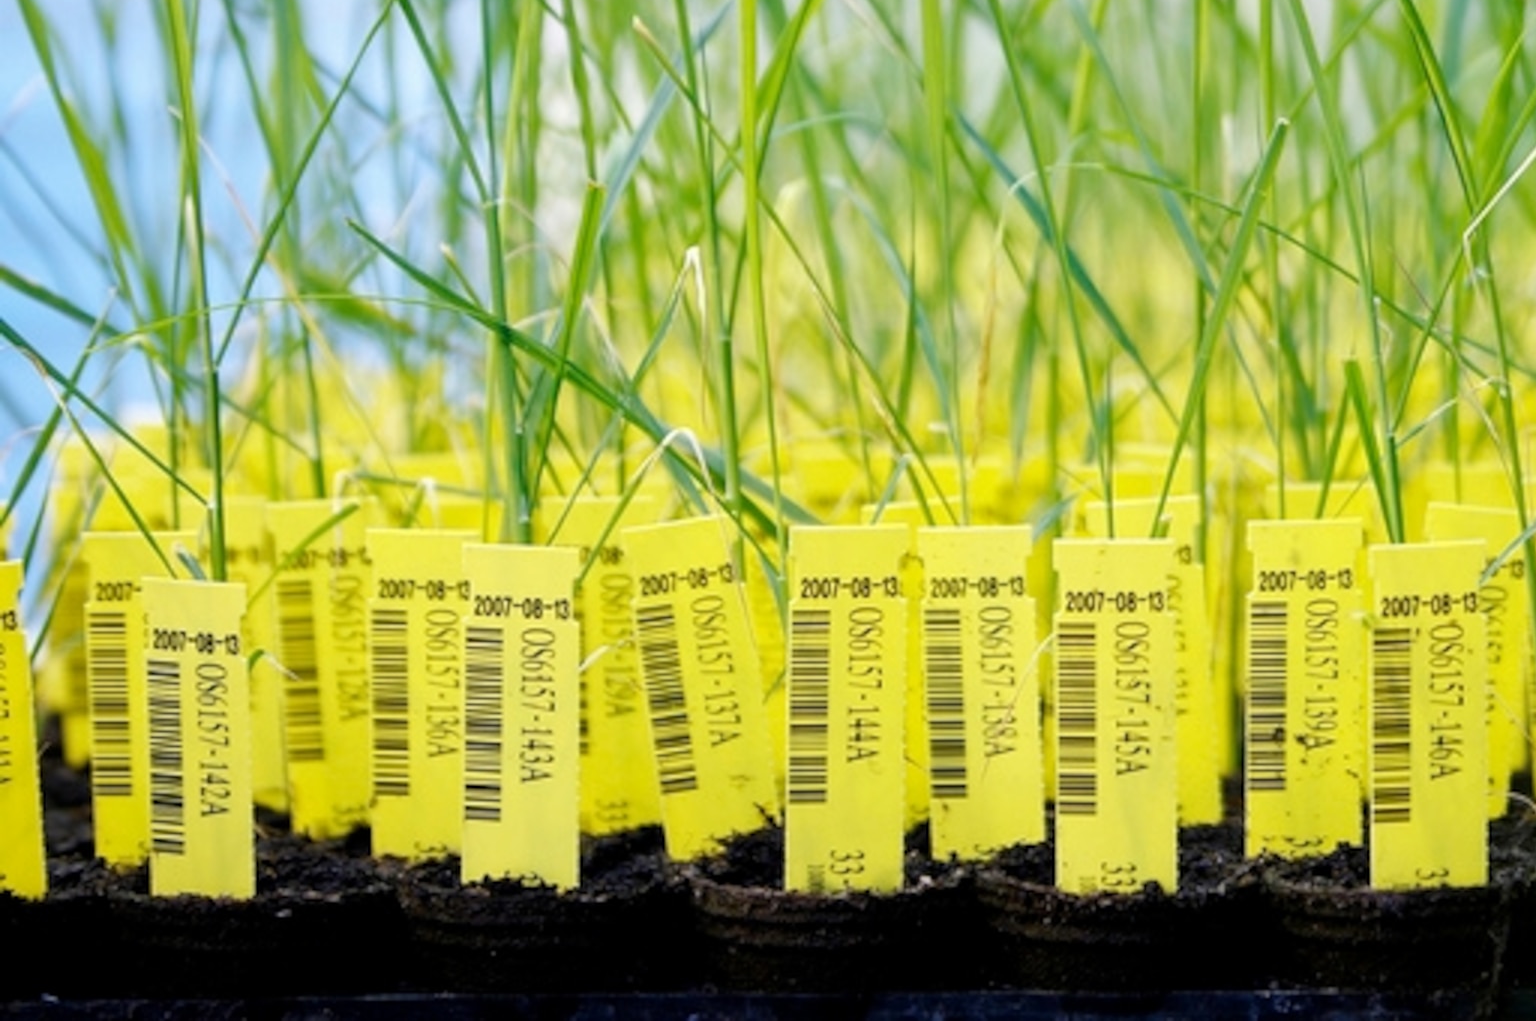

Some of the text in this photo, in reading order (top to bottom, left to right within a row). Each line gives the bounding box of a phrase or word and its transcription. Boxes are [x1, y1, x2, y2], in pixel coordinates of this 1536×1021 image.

[378, 579, 471, 600] 2007-08-13
[474, 595, 570, 619] 2007-08-13
[640, 563, 733, 595] 2007-08-13
[800, 576, 898, 599] 2007-08-13
[930, 576, 1024, 599] 2007-08-13
[1065, 591, 1165, 614] 2007-08-13
[1259, 569, 1353, 592] 2007-08-13
[1381, 592, 1478, 617] 2007-08-13
[153, 629, 239, 655] 2007-08-13
[424, 608, 460, 759] OS6157-136A
[691, 594, 742, 748] OS6157-137A
[846, 606, 883, 763] OS6157-144A
[978, 606, 1017, 758] OS6157-138A
[1304, 598, 1340, 752] OS6157-139A
[196, 663, 229, 817] OS6157-142A
[520, 627, 555, 783] OS6157-143A
[1114, 621, 1151, 777] OS6157-145A
[1428, 623, 1465, 781] OS6157-146A
